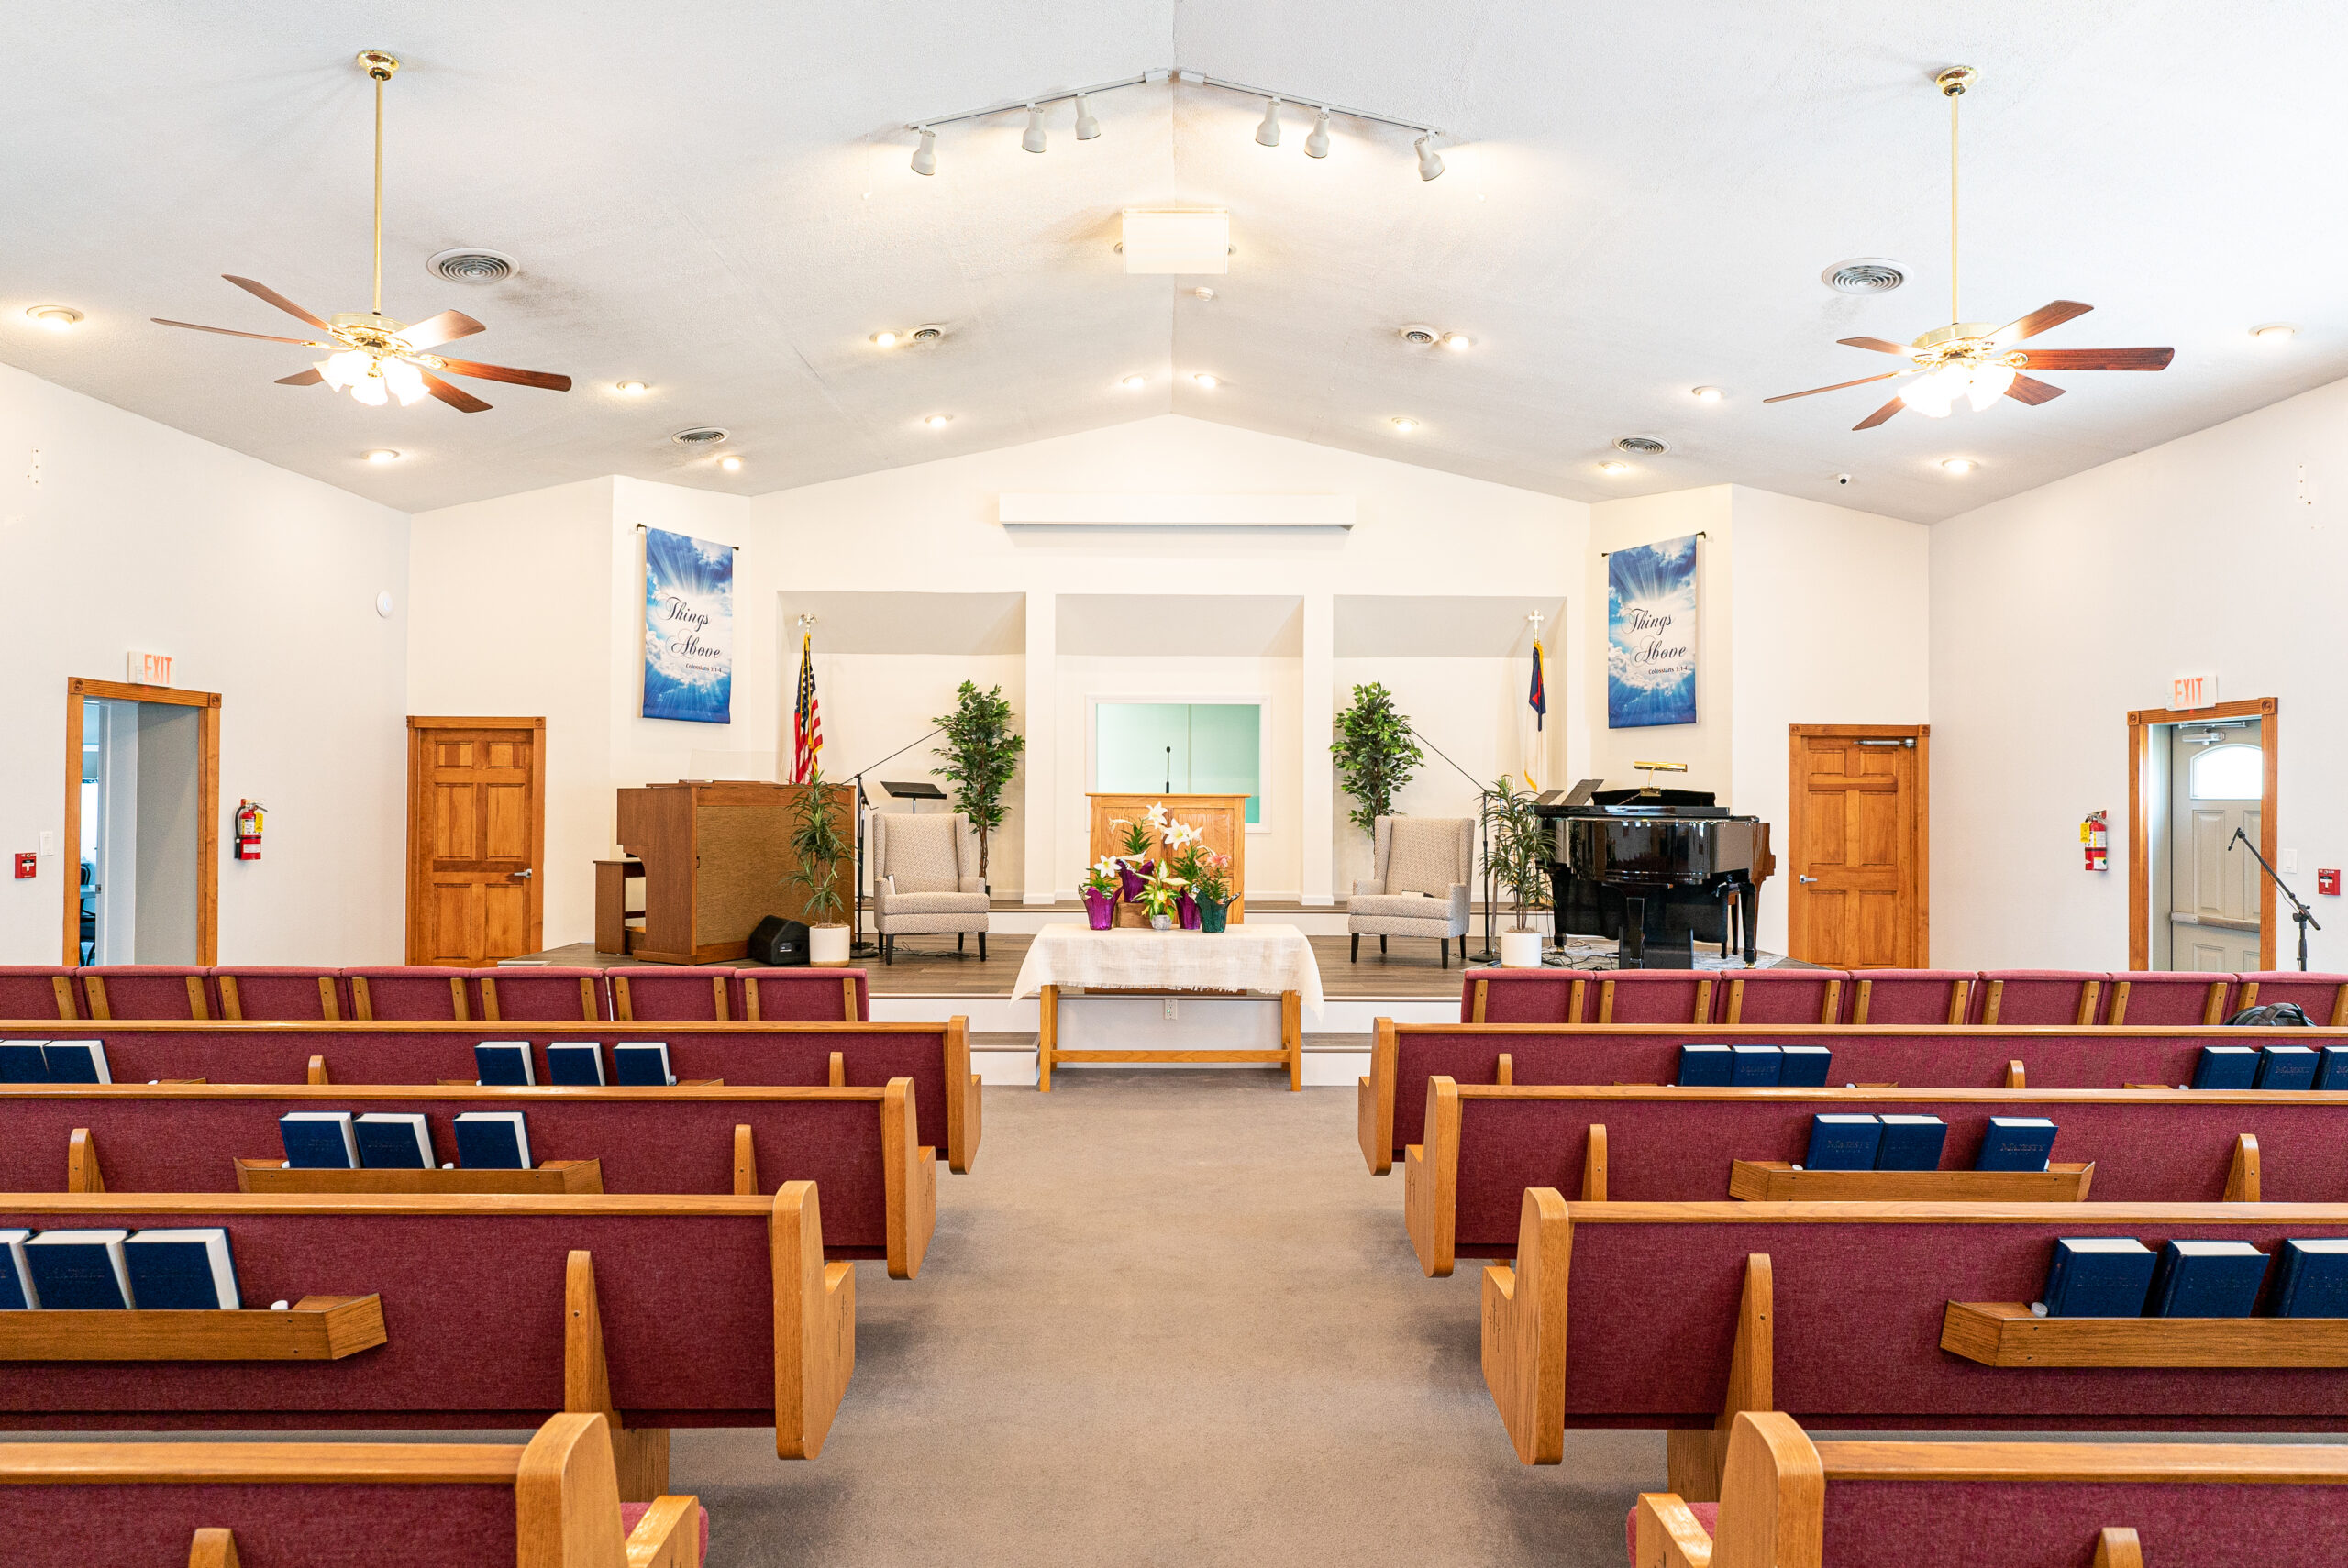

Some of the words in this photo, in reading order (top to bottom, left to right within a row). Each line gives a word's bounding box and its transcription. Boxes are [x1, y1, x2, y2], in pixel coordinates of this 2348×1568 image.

[656, 594, 709, 632] Things
[1621, 608, 1672, 635] Things
[666, 629, 722, 659] Above
[1630, 635, 1687, 668] Above
[144, 654, 172, 684] EXIT
[685, 663, 710, 671] Colossians
[2174, 677, 2203, 708] EXIT
